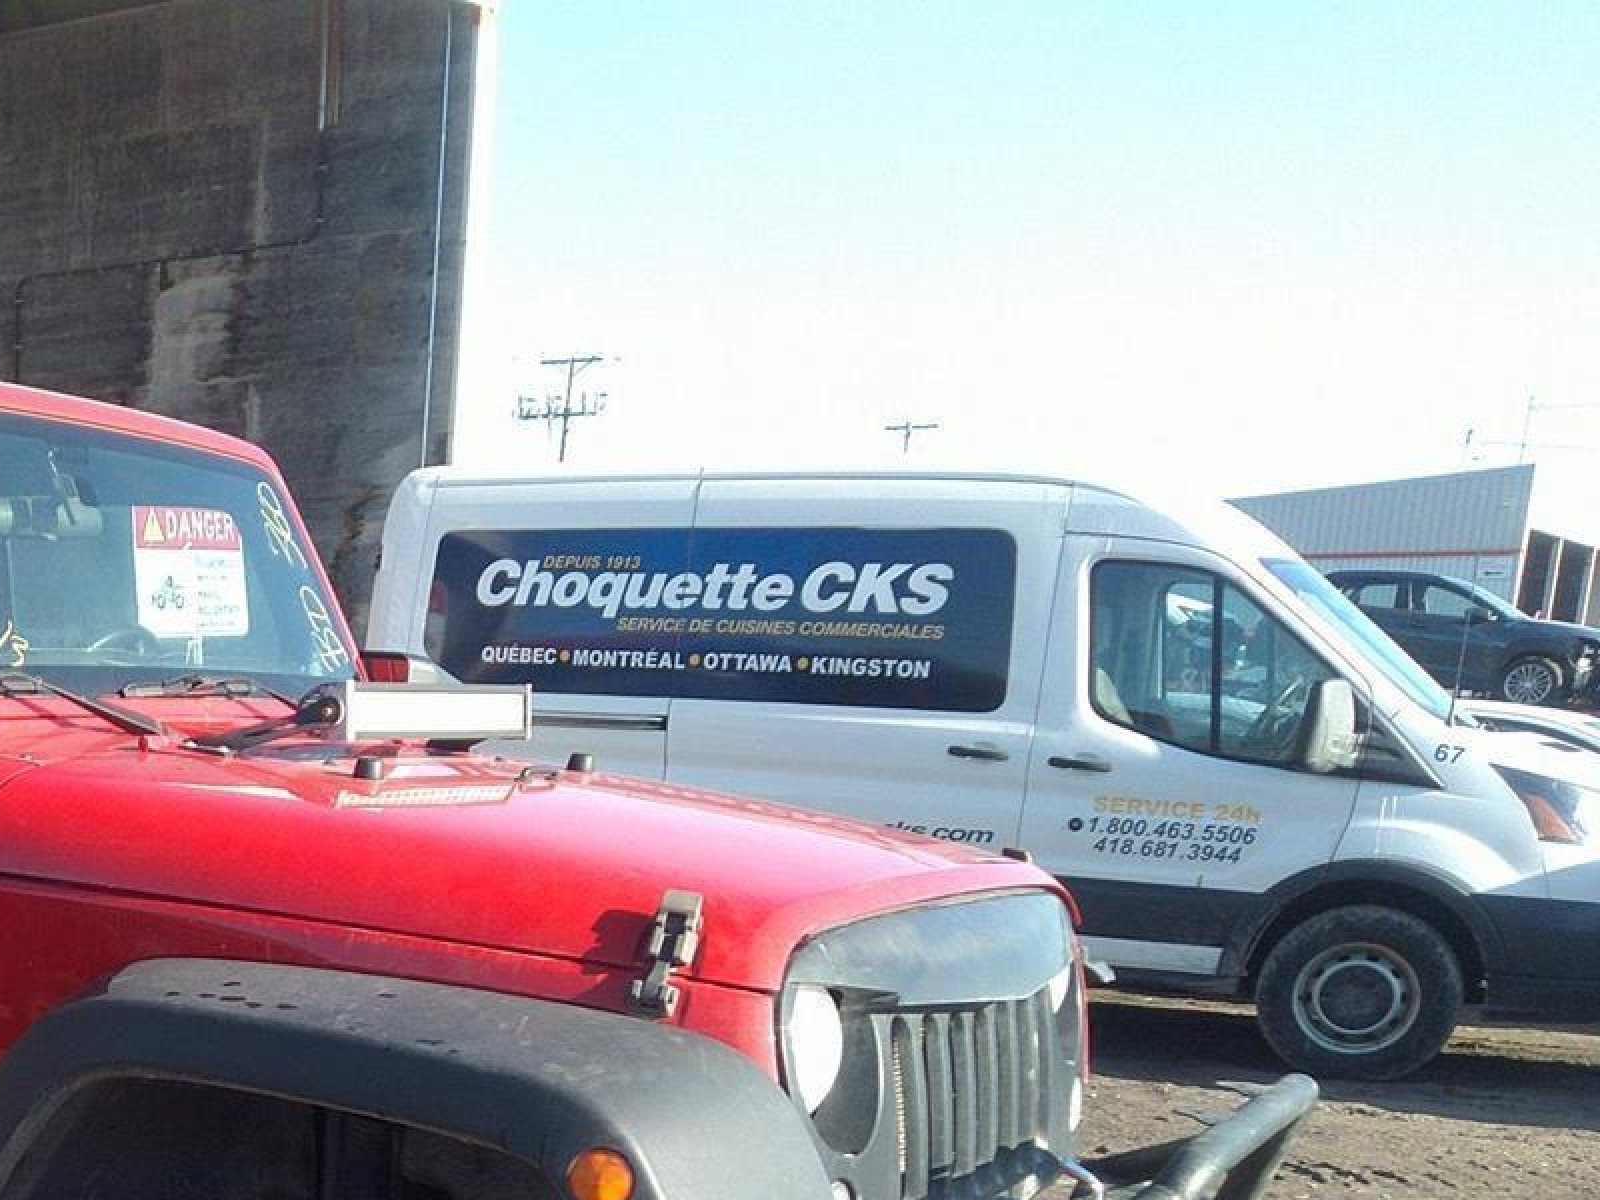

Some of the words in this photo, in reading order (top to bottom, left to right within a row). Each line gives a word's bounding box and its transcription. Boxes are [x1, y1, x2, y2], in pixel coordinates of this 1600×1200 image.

[165, 509, 236, 542] DANGER
[543, 555, 601, 569] DEPUIS
[606, 556, 641, 570] 1913
[476, 557, 795, 619] Choquette
[800, 561, 955, 615] CKS
[616, 617, 686, 632] SERVICE
[688, 619, 714, 633] DE
[715, 619, 795, 635] CUISINES
[799, 621, 945, 639] COMMERCIALES
[481, 645, 557, 665] QUÉBEC
[572, 648, 687, 669] MONTRÉAL
[703, 653, 792, 673] OTTAWA
[810, 655, 932, 679] KINGSTON
[1433, 743, 1466, 764] 67
[1093, 797, 1205, 818] SERVICE
[1213, 803, 1261, 822] 24h
[1089, 816, 1257, 845] 1.800.463.5506
[1093, 837, 1243, 863] 418.681.3944
